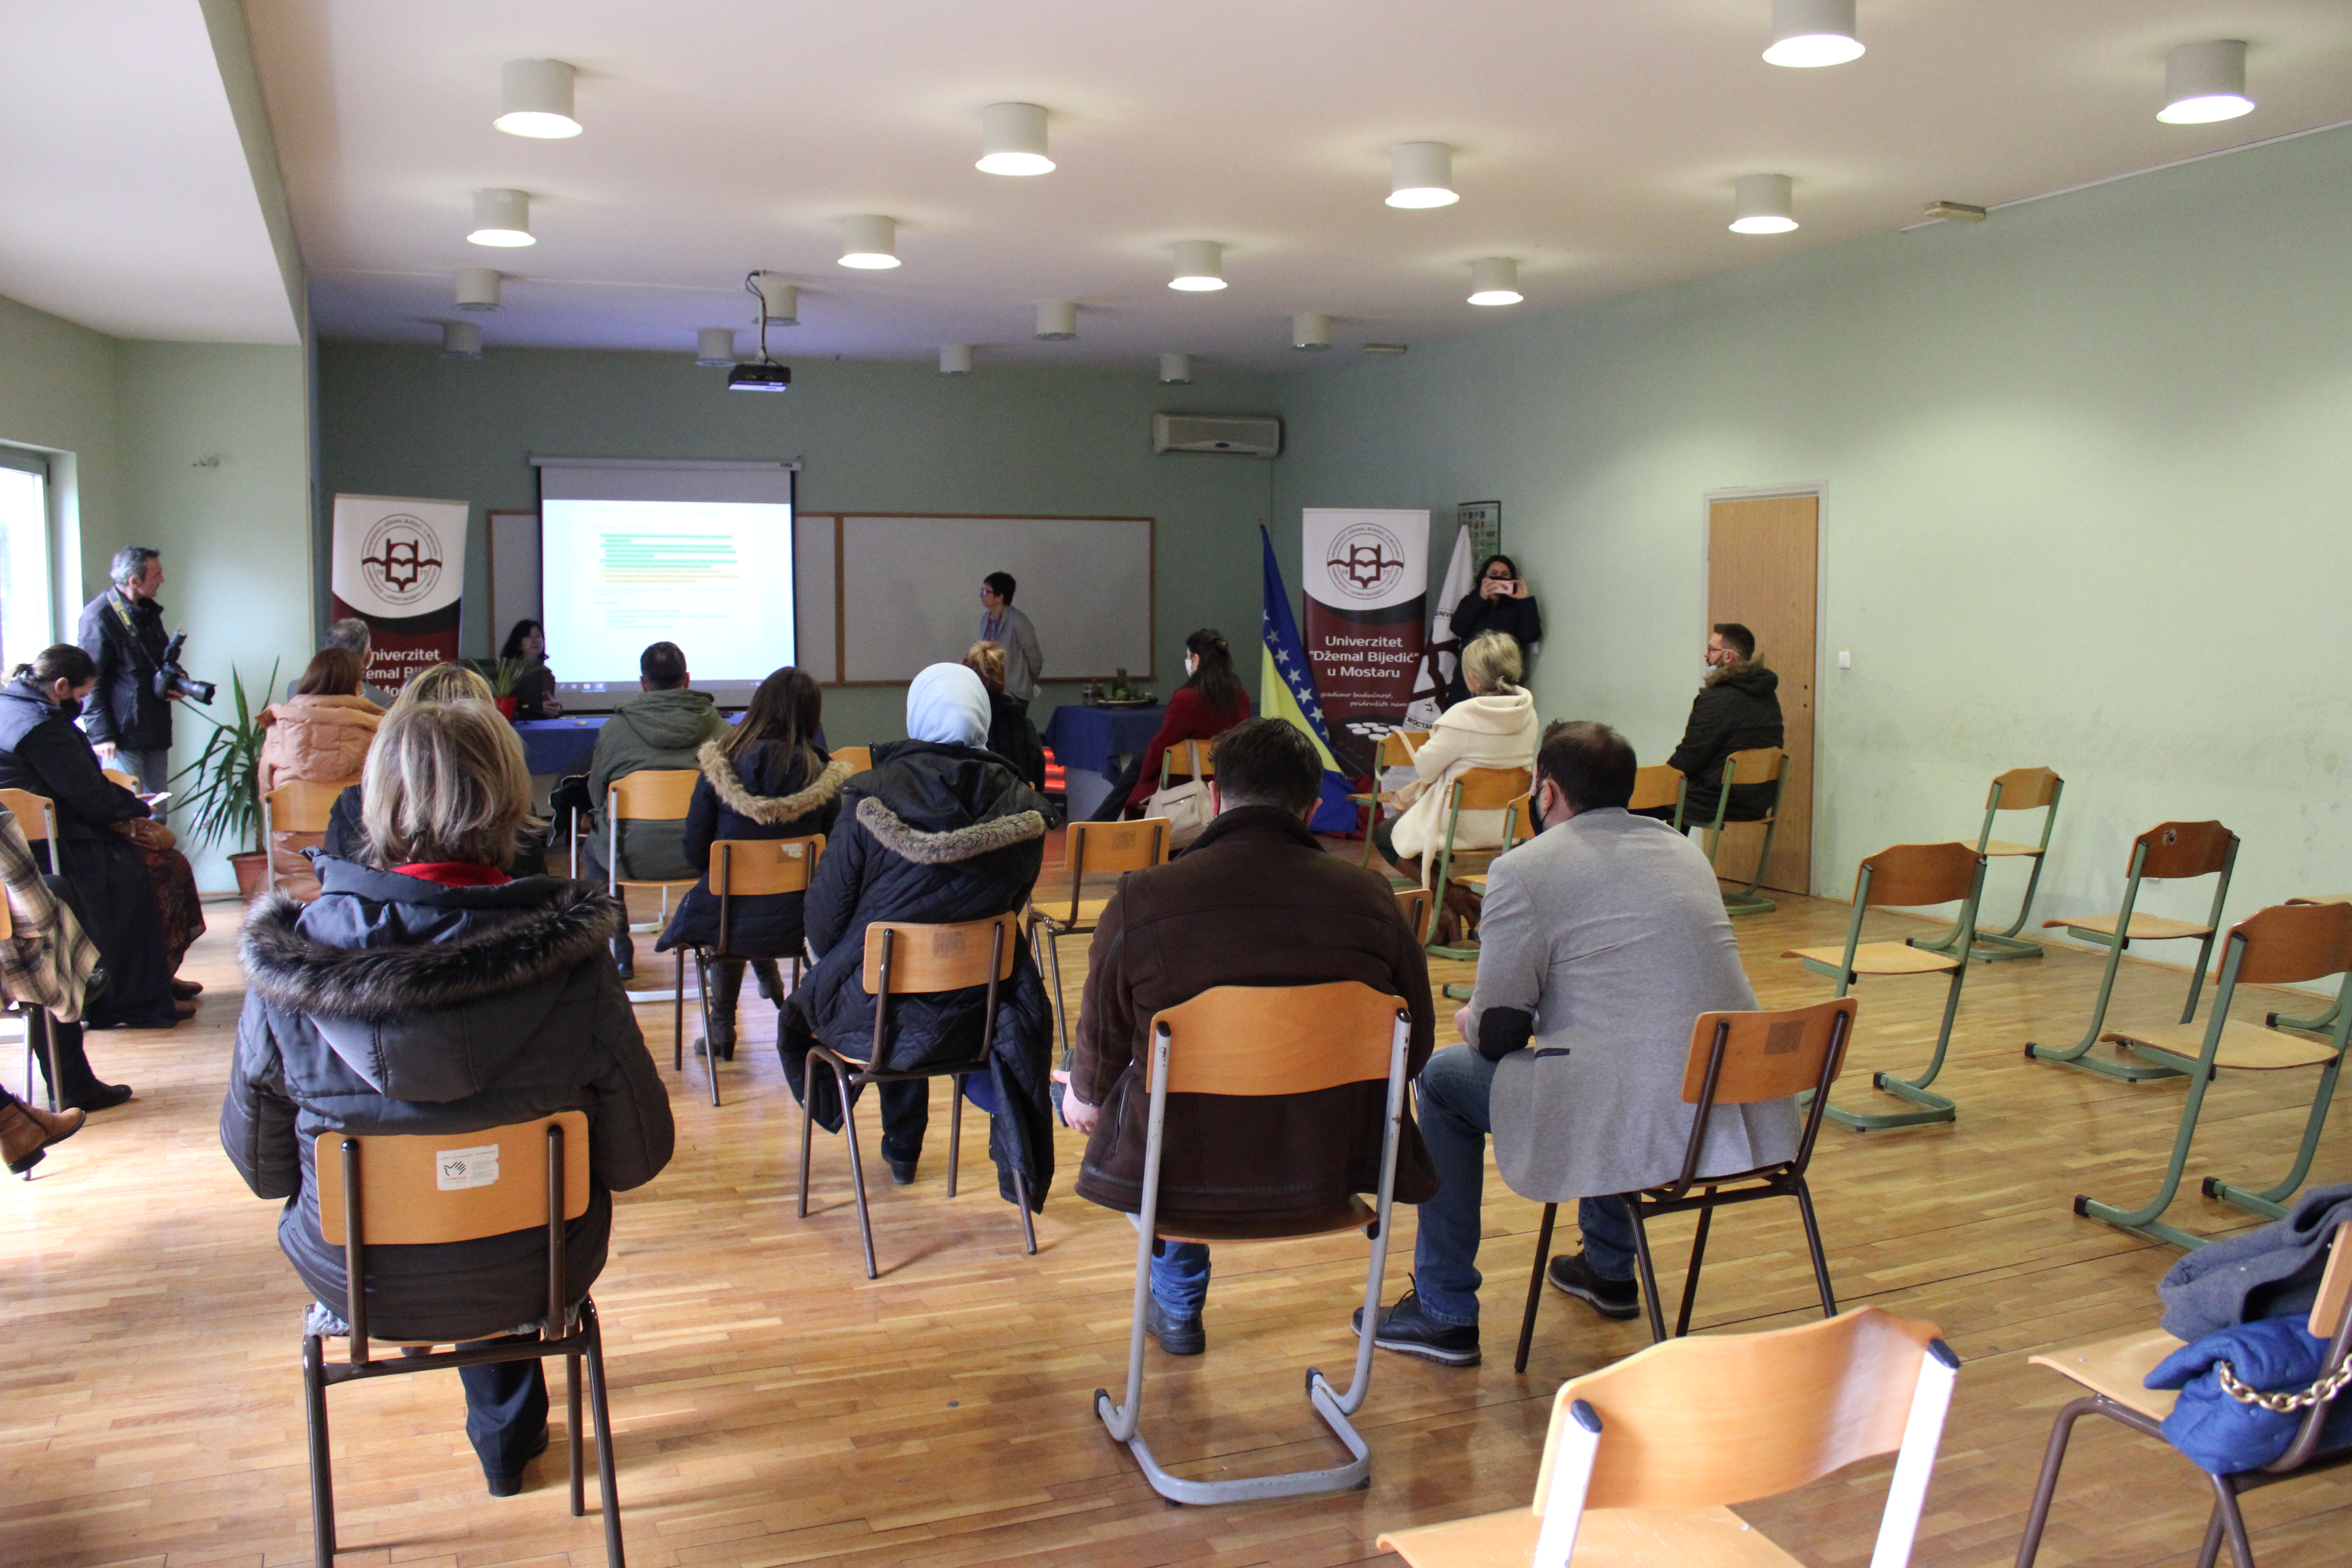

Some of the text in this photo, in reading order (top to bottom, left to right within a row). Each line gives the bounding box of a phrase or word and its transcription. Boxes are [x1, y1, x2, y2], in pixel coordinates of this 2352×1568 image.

[1325, 635, 1403, 647] Univerzitet
[372, 648, 441, 661] niverzitet
[1309, 650, 1419, 664] "Džemal Bijedić"
[1327, 666, 1400, 678] u Mostaru
